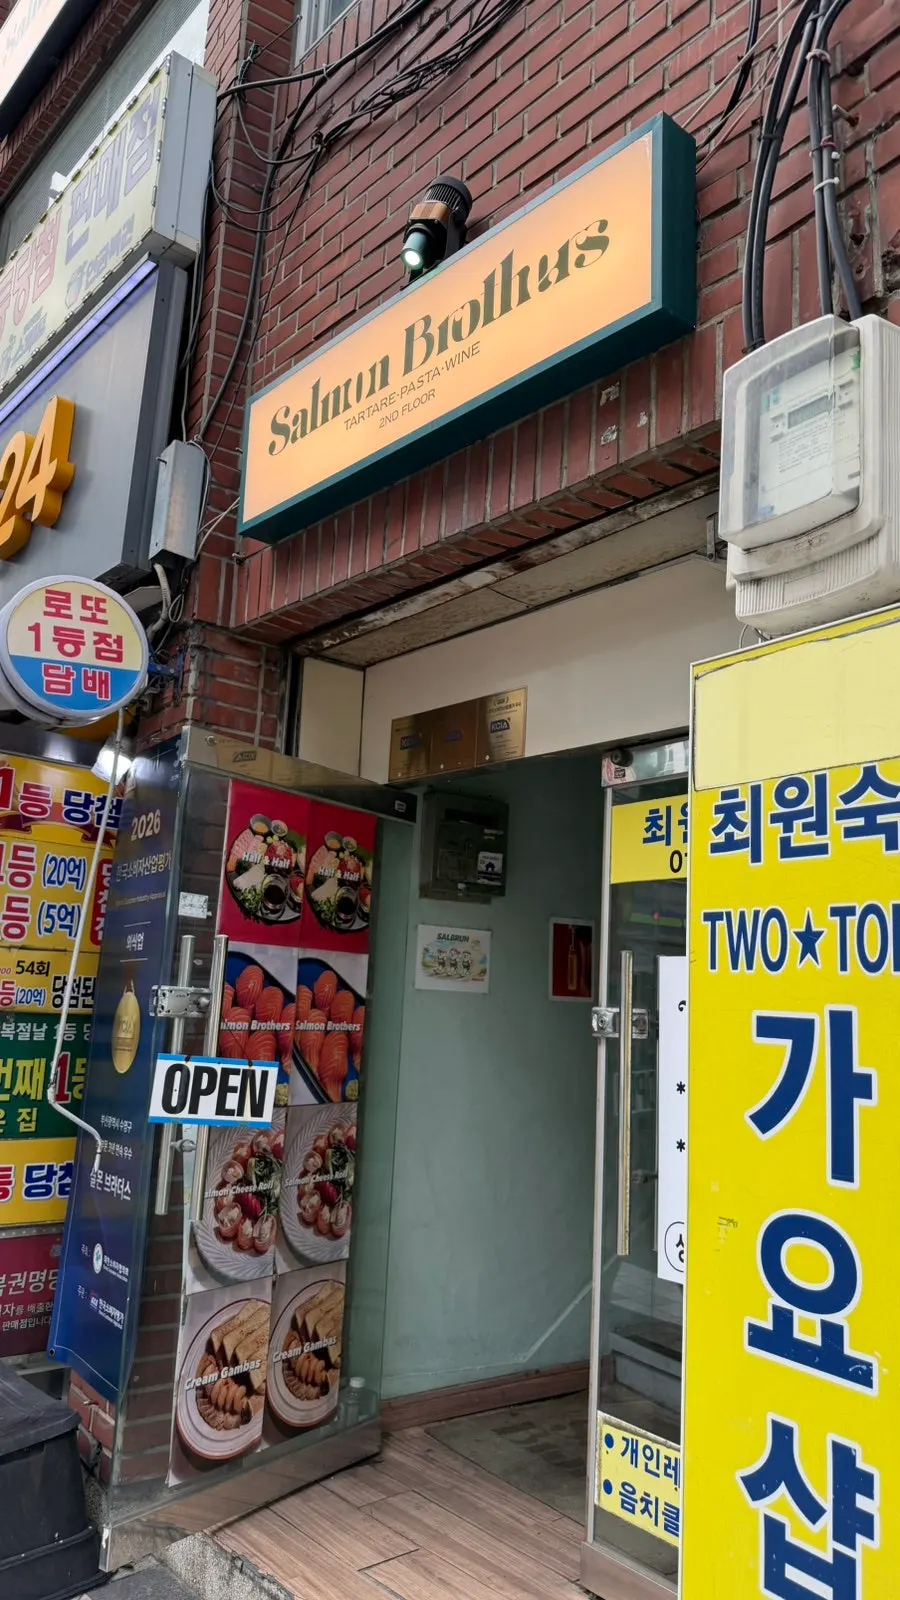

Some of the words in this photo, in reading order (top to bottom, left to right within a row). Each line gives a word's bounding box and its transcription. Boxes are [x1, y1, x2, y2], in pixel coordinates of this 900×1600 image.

[65, 84, 161, 265] 판매점
[268, 354, 391, 456] Salmon
[378, 408, 400, 430] 2ND
[401, 388, 436, 421] FLOOR
[0, 396, 68, 552] 24
[43, 589, 110, 625] 로또
[27, 622, 124, 664] 1등점
[42, 662, 112, 700] 담배
[62, 788, 123, 829] 당첨
[709, 764, 900, 865] 최원숙
[131, 809, 160, 842] 2026
[42, 852, 88, 892] (20억)
[242, 851, 262, 865] Half
[264, 855, 271, 865] &
[272, 857, 291, 869] Half
[319, 866, 335, 878] Half
[337, 871, 343, 879] &
[344, 871, 361, 882] Half
[37, 901, 82, 939] (5억)
[829, 901, 900, 976] TO
[15, 960, 51, 977] 54회
[0, 1022, 48, 1041] 복절날
[251, 1020, 291, 1031] Brothers
[295, 1020, 326, 1031] Salmon
[327, 1021, 361, 1032] Brothers
[161, 1062, 270, 1119] OPEN
[17, 1107, 38, 1133] 집
[104, 1172, 132, 1201] 브라더스
[230, 1183, 257, 1195] Cheese
[259, 1180, 274, 1190] Roll
[284, 1176, 311, 1188] Salmon
[2, 1315, 51, 1331] 판매점입니다
[272, 1346, 303, 1363] Cream
[303, 1336, 338, 1353] Gambas
[184, 1371, 218, 1391] Cream
[220, 1358, 262, 1378] Gambas
